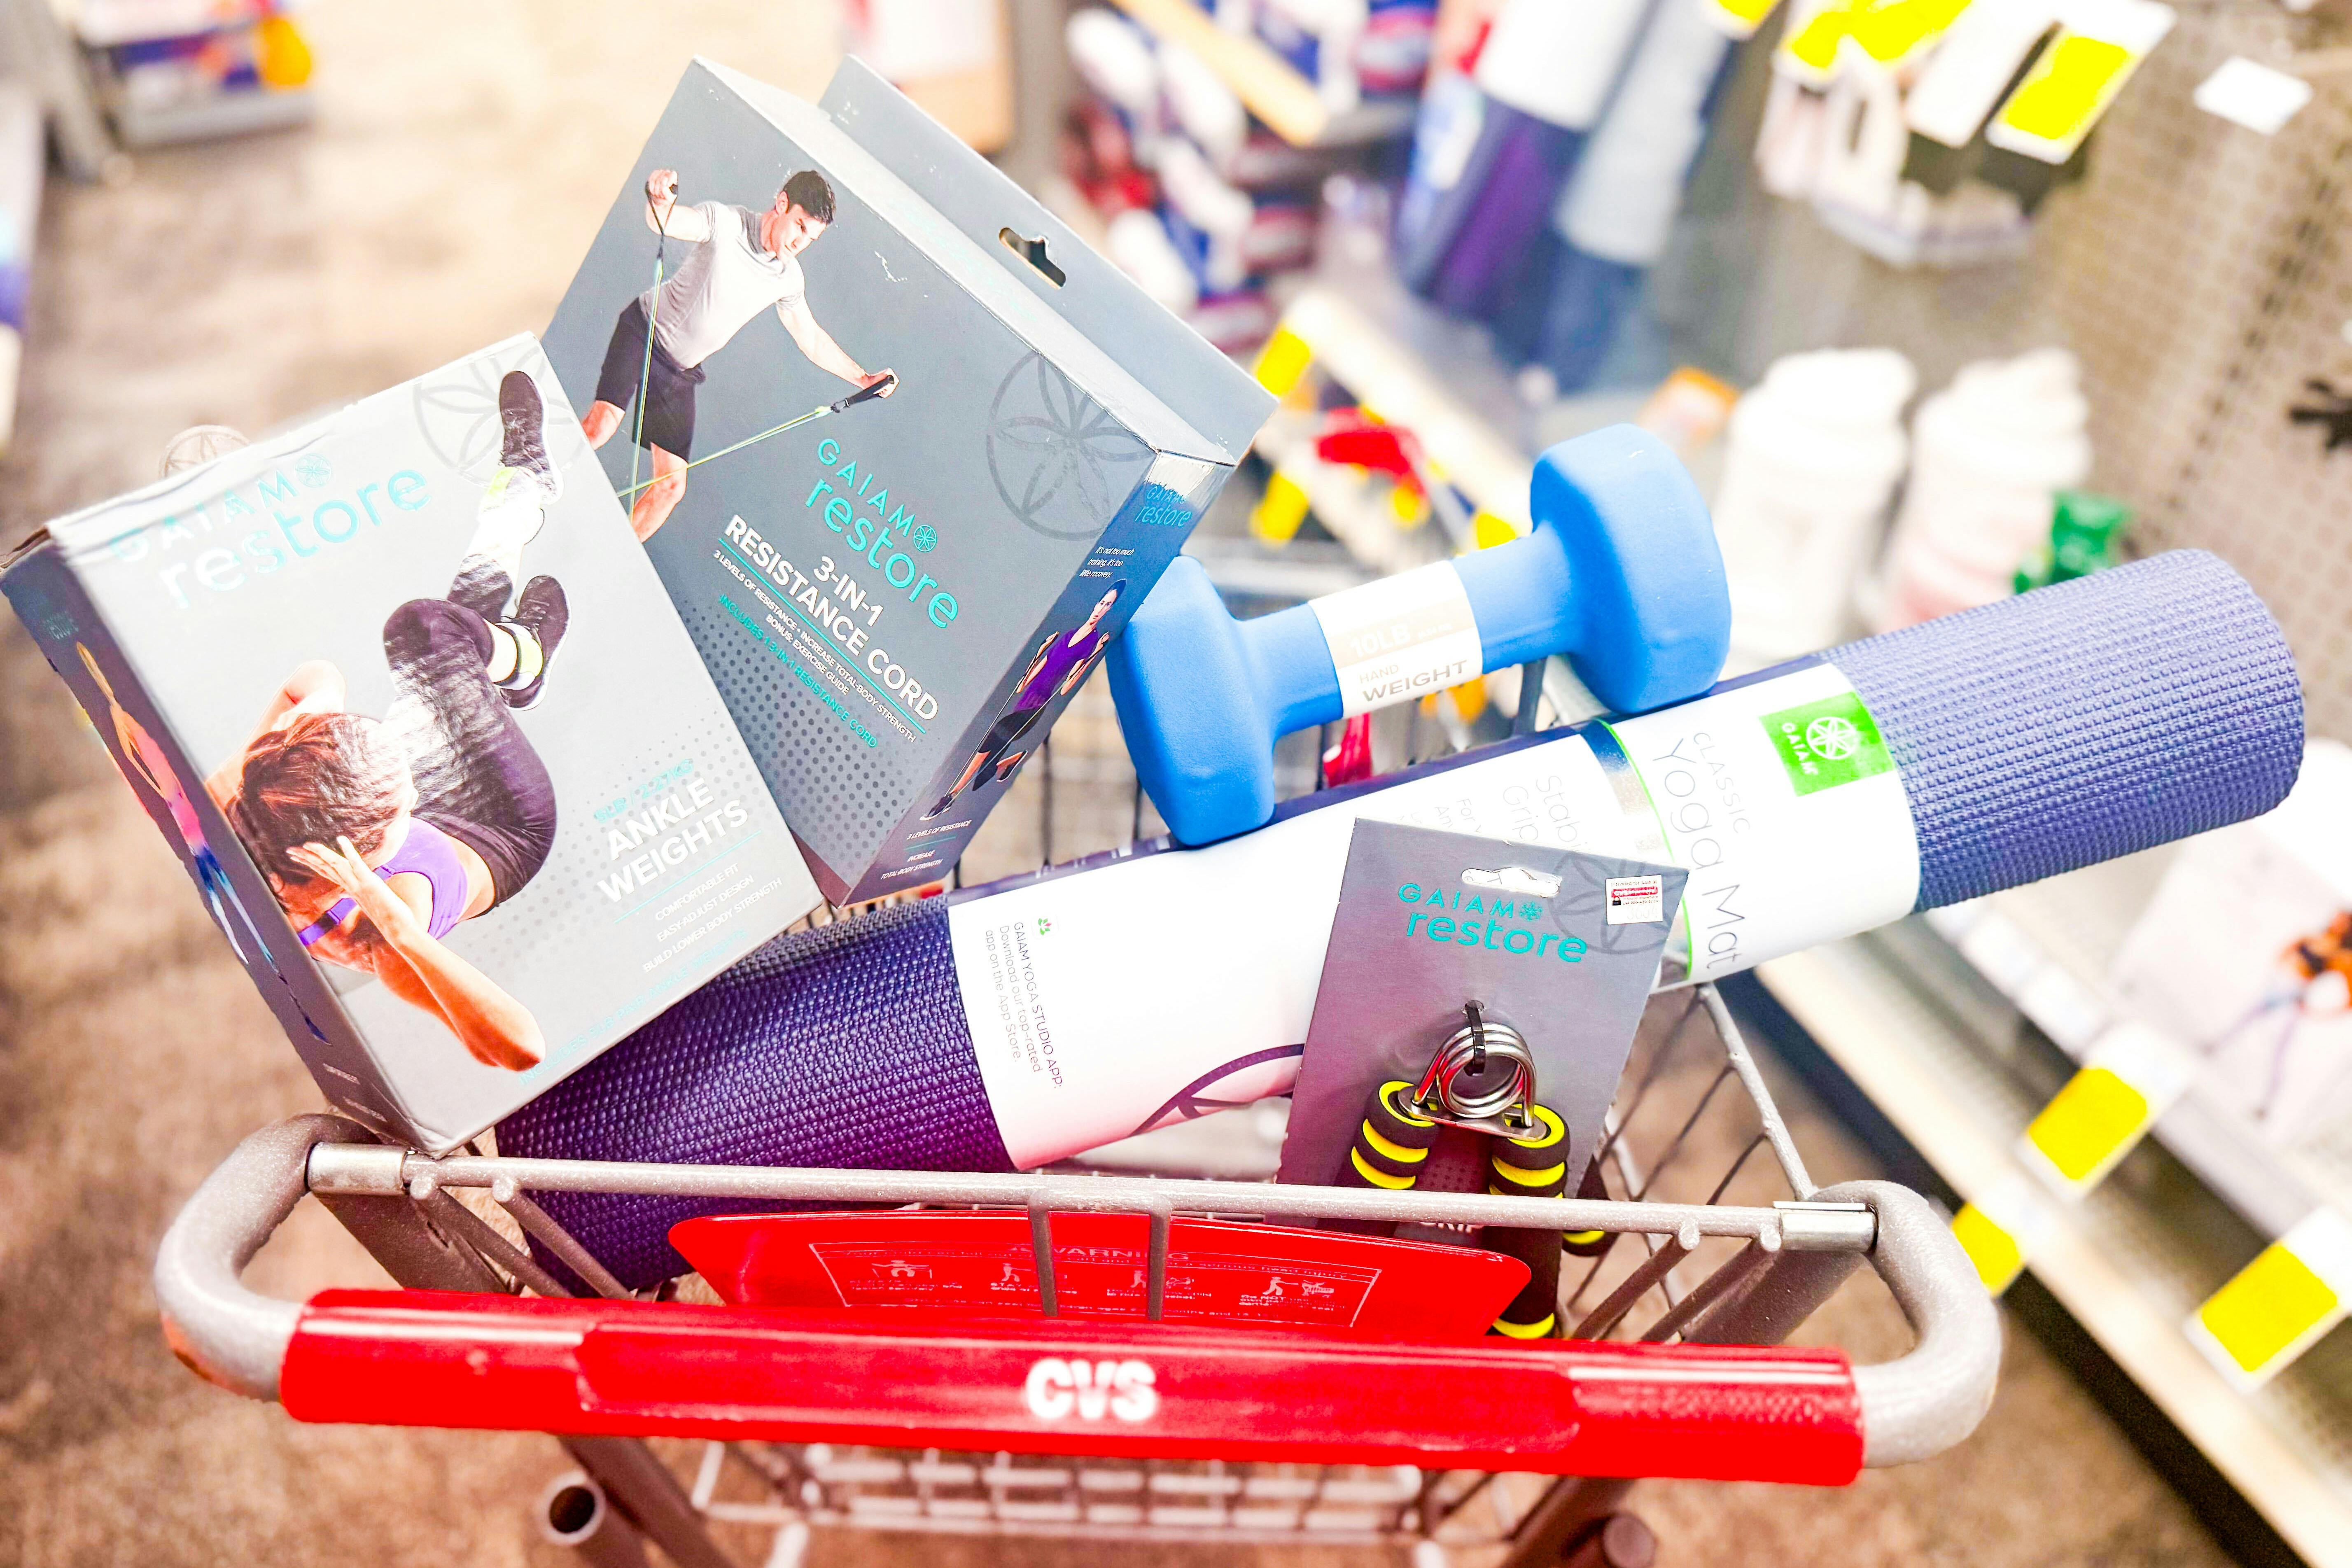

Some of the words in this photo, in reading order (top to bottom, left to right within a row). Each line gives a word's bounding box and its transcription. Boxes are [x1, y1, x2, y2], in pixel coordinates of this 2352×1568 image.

[817, 437, 916, 537] GAIAM
[1134, 504, 1193, 527] restore
[156, 469, 432, 609] restore
[805, 479, 959, 629] restore
[724, 514, 869, 657] RESISTANCE
[868, 649, 938, 720] CORD
[813, 556, 884, 628] 3-IN-1
[713, 550, 721, 559] 3
[719, 555, 746, 581] LEVELS
[744, 578, 757, 590] OF
[754, 588, 798, 630] RESISTANCE
[800, 631, 836, 667] INCREASE
[835, 663, 879, 706] TOTAL-BODY
[877, 704, 917, 743] STRENGTH
[719, 593, 764, 641] INCLUDES
[793, 665, 850, 722] RESISTANCE
[849, 718, 878, 748] CORD
[766, 614, 794, 643] BONUS:
[792, 639, 828, 674] EXERCISE
[825, 670, 850, 695] GUIDE
[1351, 624, 1411, 657] 10LB
[1360, 664, 1399, 684] HAND
[1362, 660, 1467, 702] WEIGHT
[1781, 722, 1819, 775] GAIAM
[1456, 798, 1476, 822] For
[1693, 732, 1750, 834] CLASSIC
[608, 777, 715, 861] ANKLE
[910, 828, 932, 839] LEVELS
[597, 800, 748, 902] WEIGHTS
[1652, 737, 1724, 870] Yoga
[1701, 884, 1745, 969] Mat
[655, 871, 726, 921] COMFORTABLE
[724, 863, 739, 877] FIT
[656, 897, 719, 942] EASY-ADJUST
[719, 875, 755, 902] DESIGN
[1398, 883, 1514, 919] GAIAM
[642, 949, 673, 973] BUILD
[673, 926, 707, 954] LOWER
[707, 908, 734, 931] BODY
[733, 877, 783, 913] STRENGTH
[985, 929, 996, 952] app
[999, 925, 1020, 983] Download
[1407, 912, 1587, 963] restore
[989, 954, 999, 969] on
[992, 970, 1004, 991] the
[518, 1034, 589, 1085] INCLUDES
[649, 964, 691, 1001] ANKLE
[691, 928, 749, 970] WEIGHTS
[998, 994, 1011, 1021] App
[1012, 986, 1024, 1006] our
[1014, 921, 1030, 961] GAIAM
[1022, 962, 1039, 1003] YOGA
[1032, 1004, 1053, 1055] STUDIO
[1046, 1058, 1063, 1089] APP:
[1006, 1024, 1022, 1063] Store.
[1017, 1009, 1043, 1073] top-rated
[1053, 1247, 1189, 1260] ARNIG
[1026, 1358, 1160, 1421] CVS
